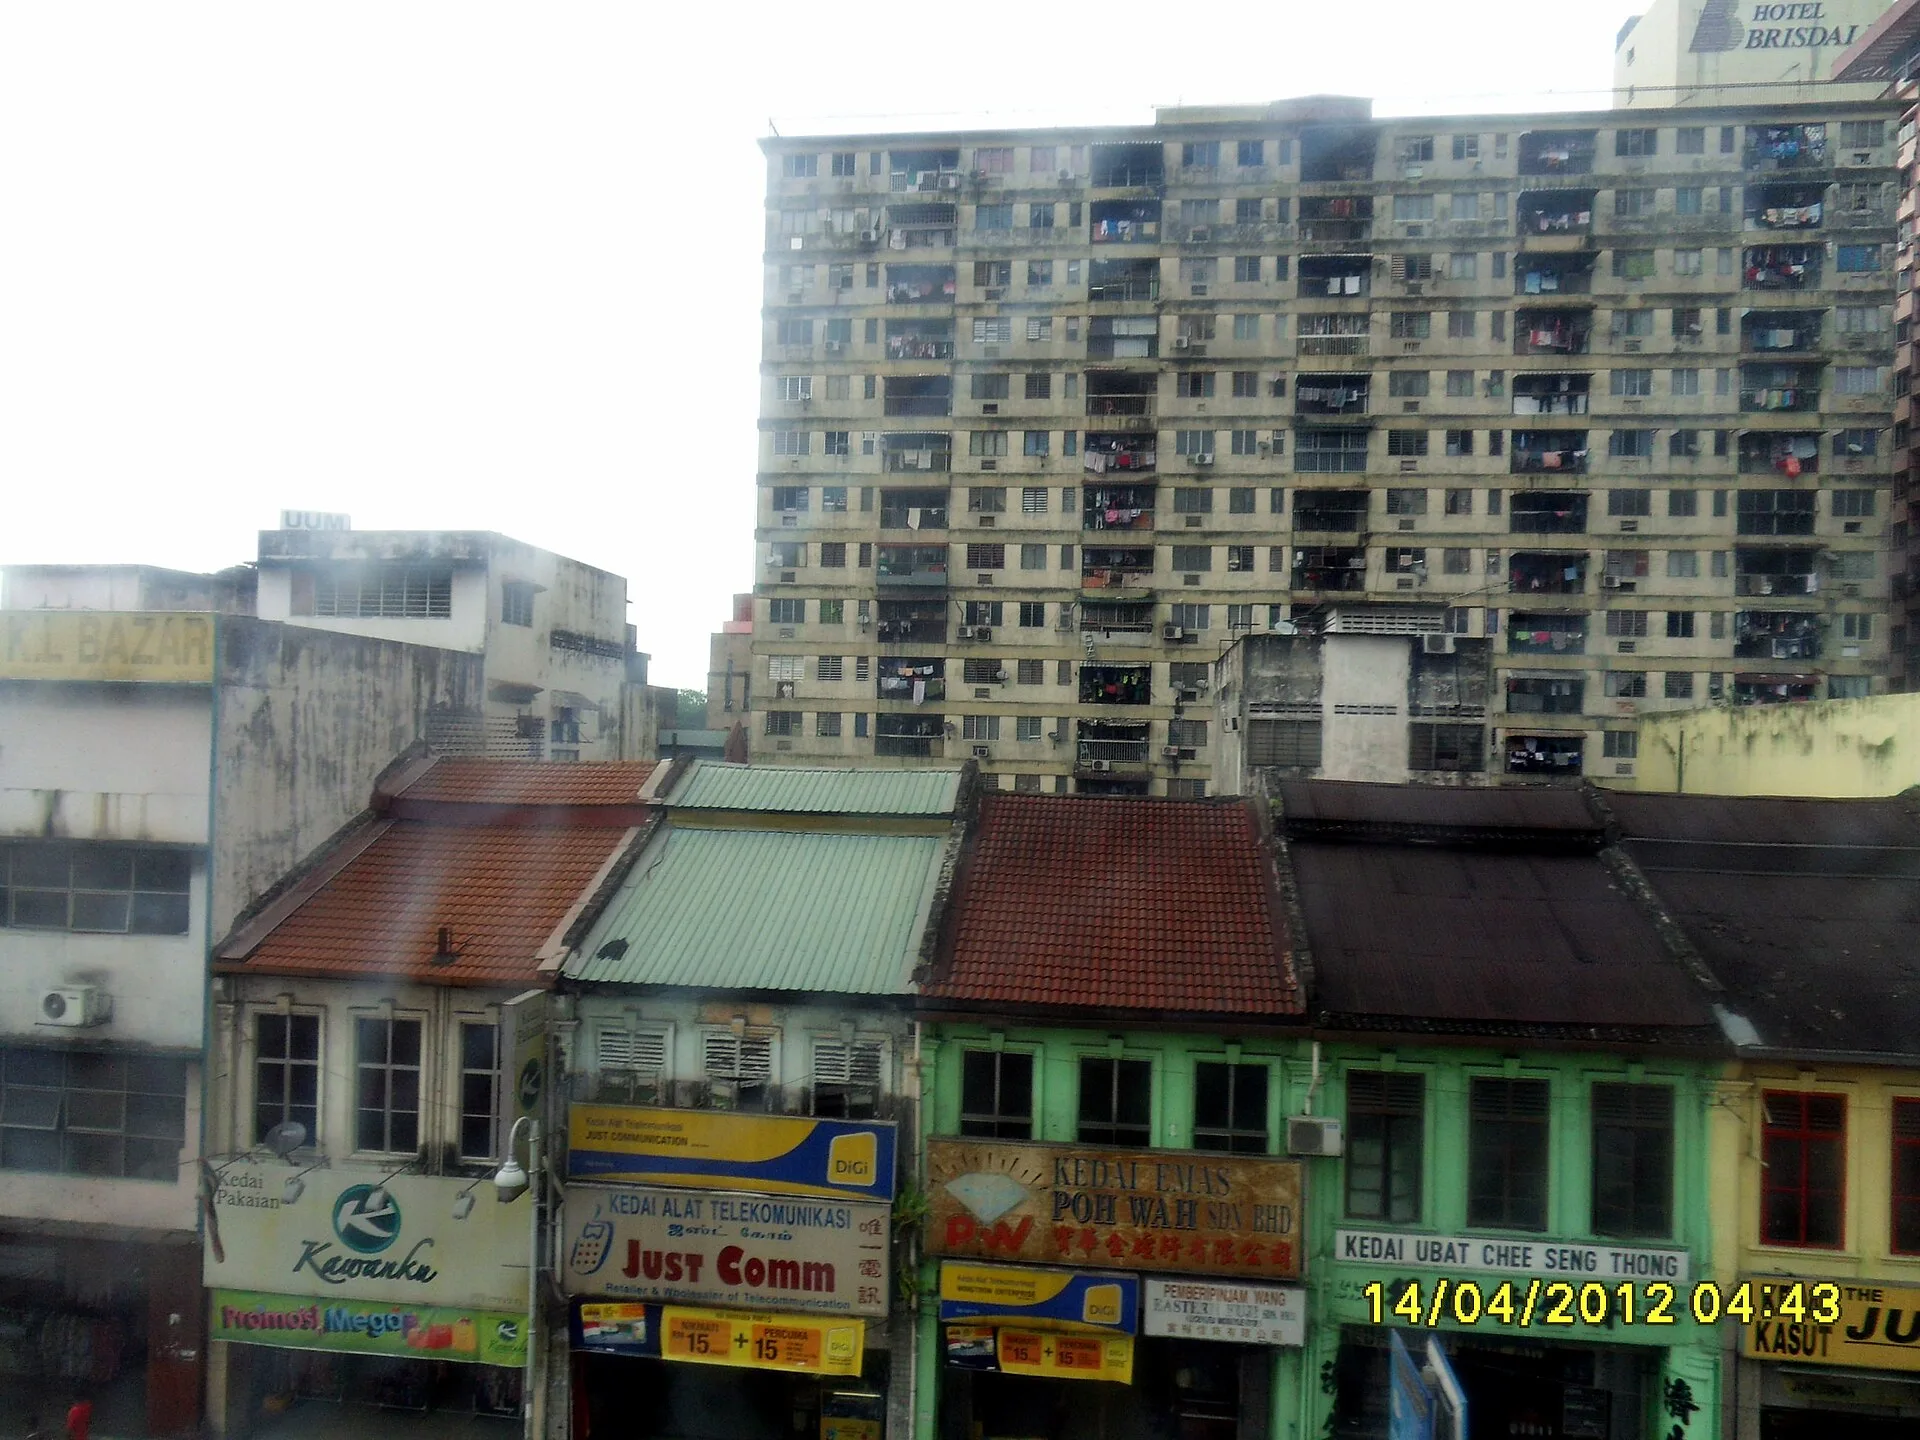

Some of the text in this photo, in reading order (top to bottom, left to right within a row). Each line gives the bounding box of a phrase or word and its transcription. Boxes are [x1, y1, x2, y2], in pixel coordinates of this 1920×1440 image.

[1752, 2, 1825, 22] HOTEL
[78, 615, 209, 665] BAZAR
[586, 1131, 608, 1141] JUST
[611, 1132, 688, 1146] COMMUNICATION
[217, 1171, 264, 1189] Kedai
[1052, 1156, 1232, 1196] KEDAI EMAS
[215, 1189, 280, 1209] Pakaian
[609, 1197, 852, 1230] KEDAI ALAT TELEKOMUNIKASI
[1051, 1189, 1117, 1225] POH
[1129, 1195, 1199, 1231] WAH
[1252, 1204, 1292, 1235] BHD
[292, 1239, 438, 1285] Kawanku
[1345, 1235, 1678, 1277] KEDAI UBAT CHEE SENG THONG
[728, 1291, 739, 1301] of
[744, 1292, 850, 1310] Telecommunication
[1255, 1290, 1287, 1308] WANG
[1845, 1287, 1883, 1303] THE
[687, 1331, 710, 1355] 15
[1755, 1320, 1834, 1357] KASUT
[755, 1338, 778, 1361] 15
[1013, 1347, 1029, 1361] 15
[1058, 1351, 1074, 1365] 15
